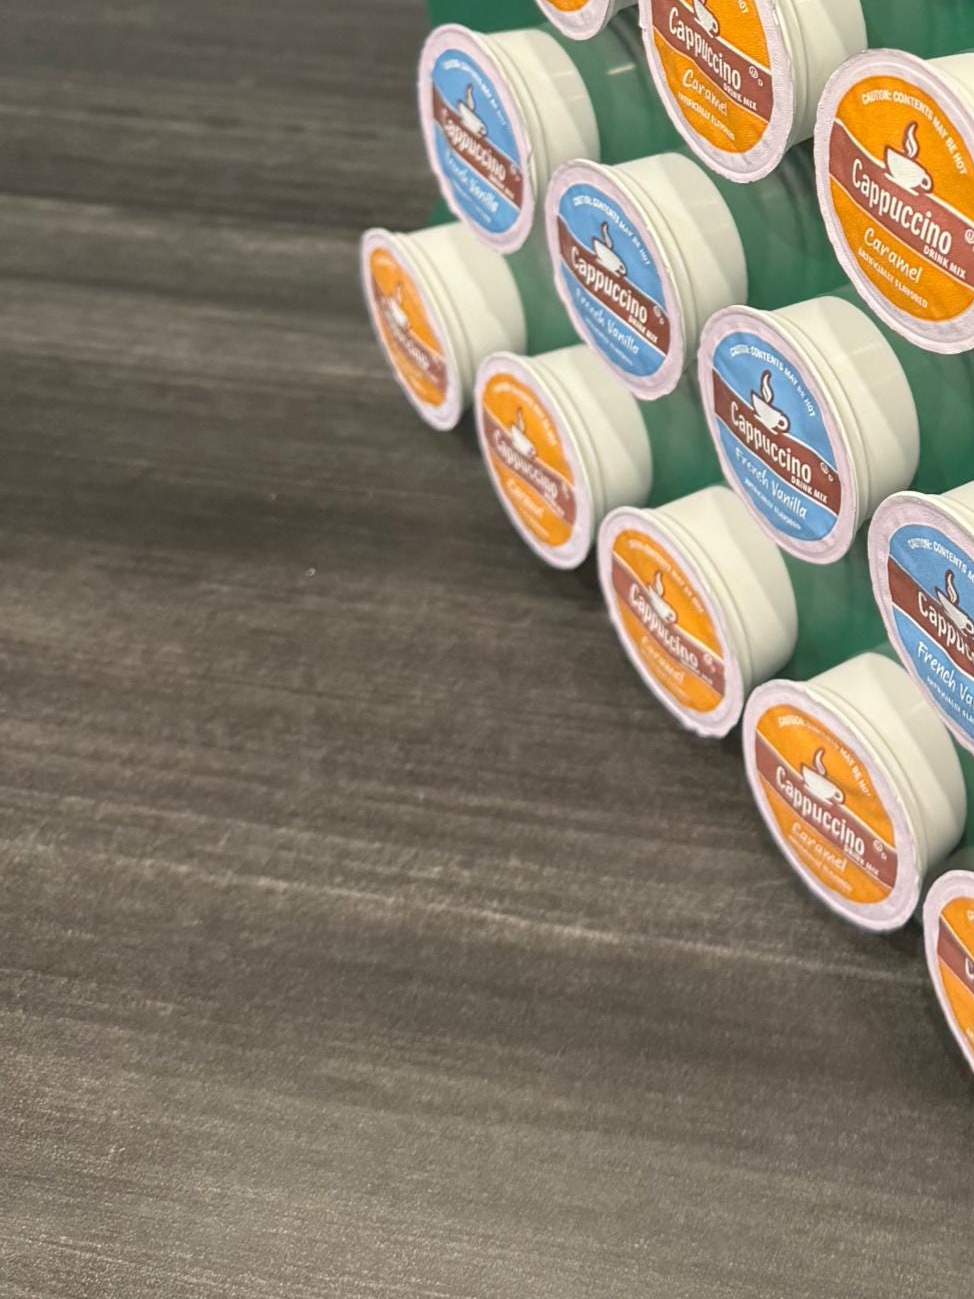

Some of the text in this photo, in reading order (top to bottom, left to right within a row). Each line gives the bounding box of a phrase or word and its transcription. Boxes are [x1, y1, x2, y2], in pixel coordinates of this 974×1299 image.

[668, 7, 741, 90] Cappuccino
[682, 68, 728, 116] Caramel
[892, 88, 934, 120] CONTENTS
[931, 115, 948, 140] MAY
[945, 137, 958, 157] BE
[954, 154, 969, 175] HOT
[852, 158, 952, 255] Cappuccino
[863, 227, 923, 283] Caramel
[923, 245, 967, 280] DRINK MIX
[571, 246, 648, 324] Cappuccino
[783, 366, 798, 385] MAY
[731, 401, 812, 483] Cappuccino
[771, 480, 808, 519] Vanilla
[790, 475, 828, 504] DRINK MIX
[932, 539, 967, 575] CONTENTS
[916, 641, 957, 693] French
[776, 765, 865, 856] Cappuccino
